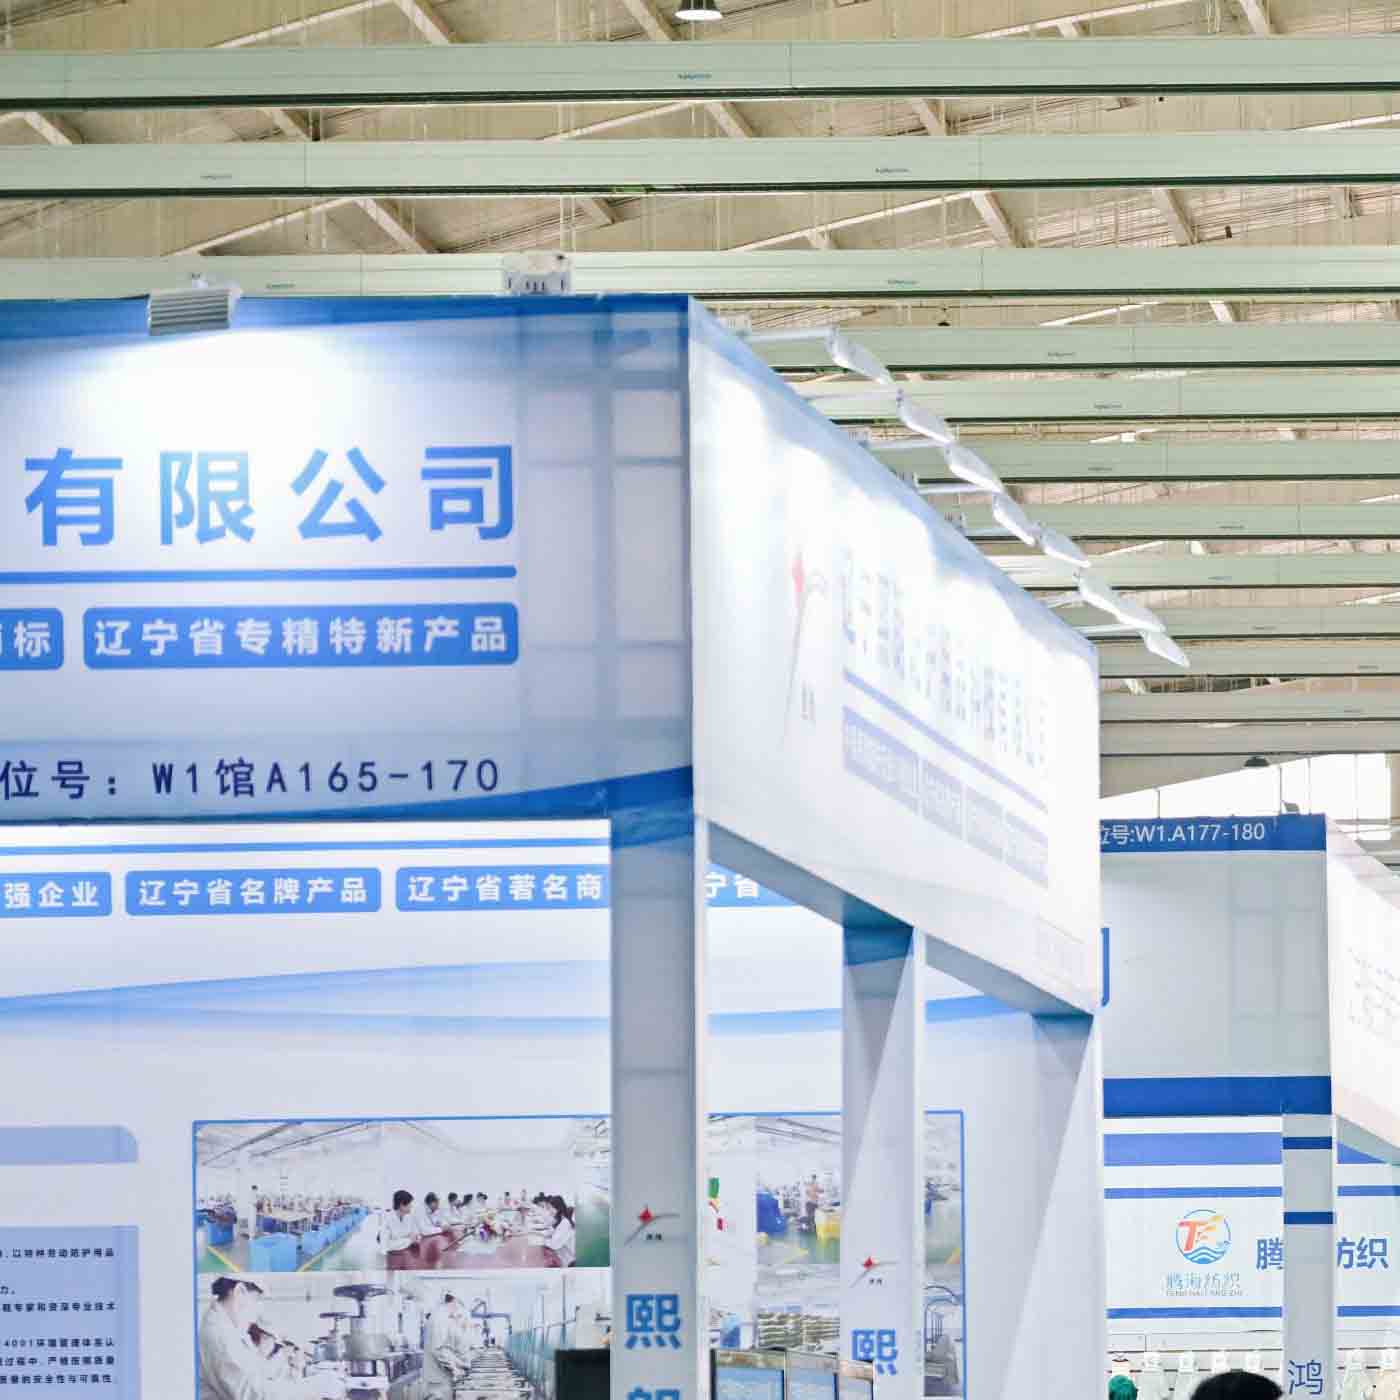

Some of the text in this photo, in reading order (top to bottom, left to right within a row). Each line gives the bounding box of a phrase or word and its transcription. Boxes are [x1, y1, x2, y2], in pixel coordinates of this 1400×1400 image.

[24, 444, 515, 547] 有限公司
[0, 619, 52, 659] 标
[94, 615, 509, 657] 辽宁省专精特新产品
[4, 880, 99, 909] 强企业
[138, 876, 368, 906] 辽宁省名牌产品
